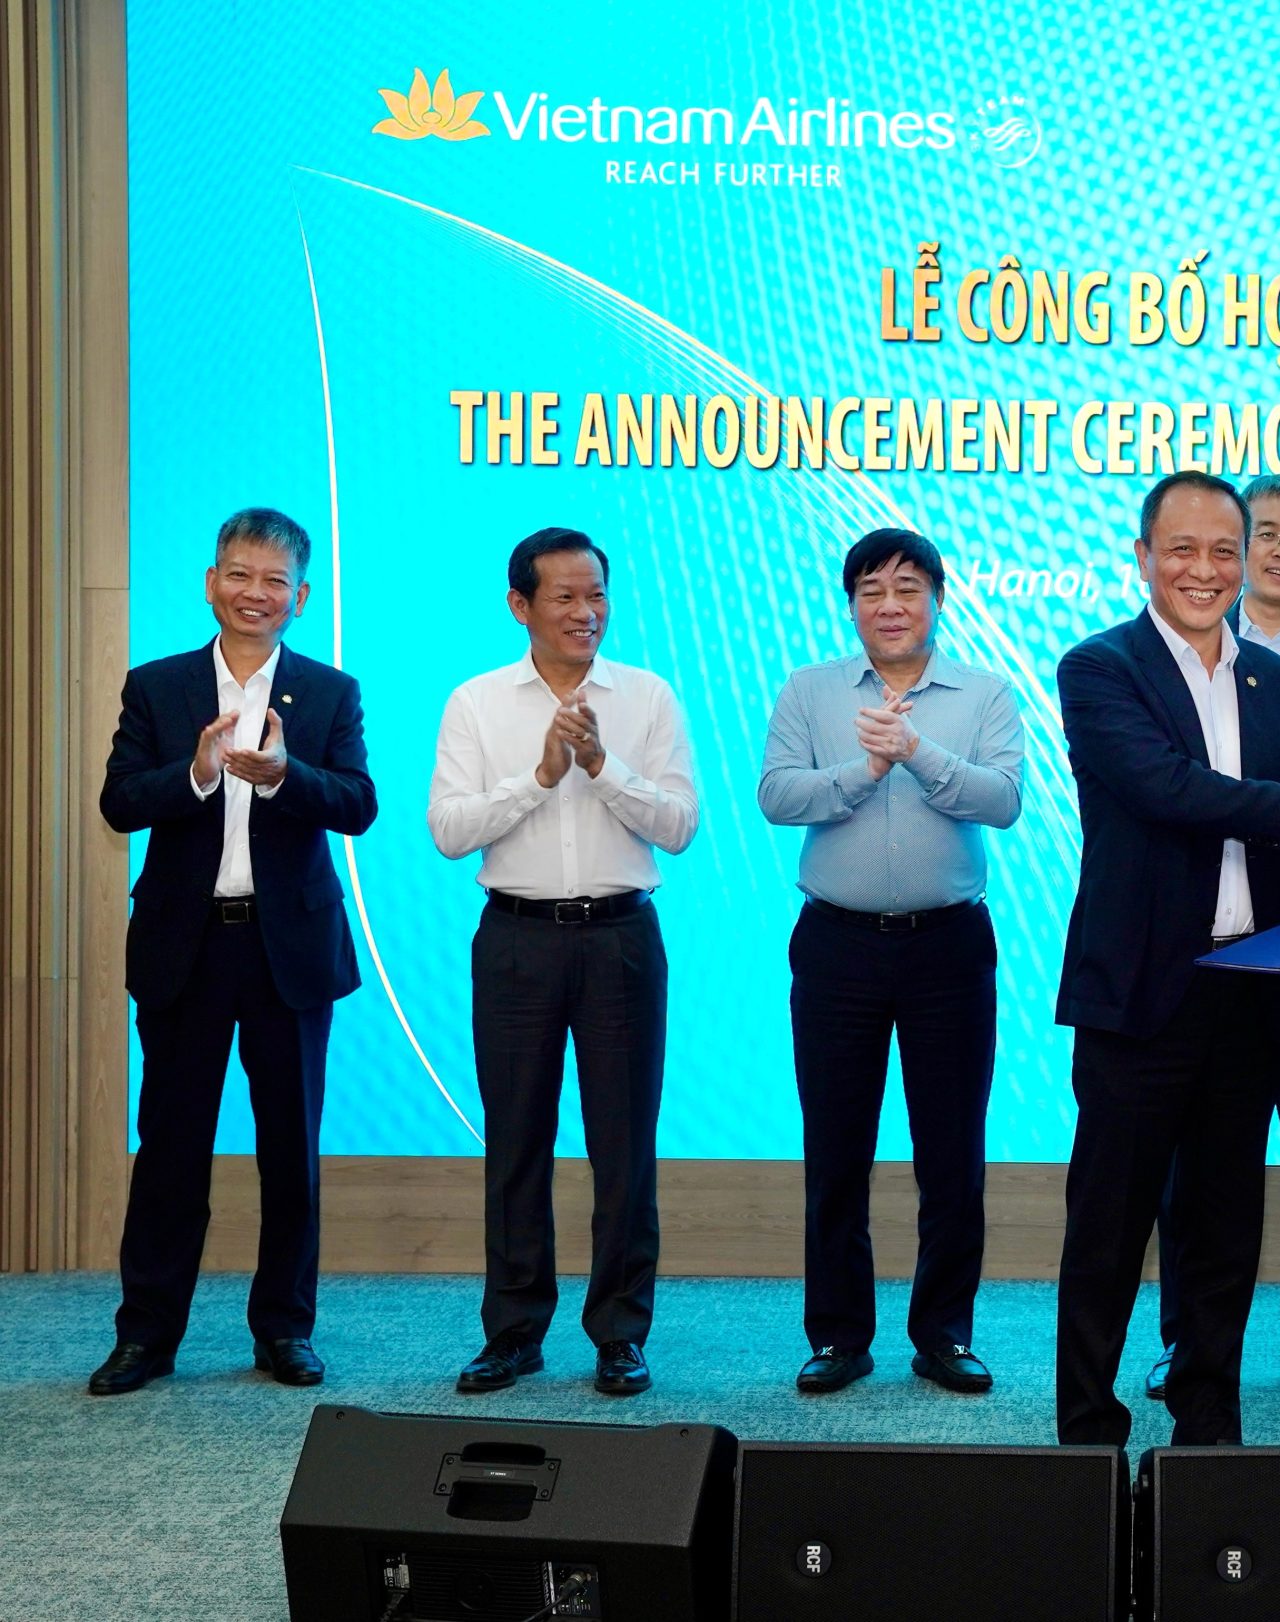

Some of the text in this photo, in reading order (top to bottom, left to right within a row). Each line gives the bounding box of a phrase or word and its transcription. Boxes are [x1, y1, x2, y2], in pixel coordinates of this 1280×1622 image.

[493, 91, 956, 150] Vietnam Airlines
[606, 161, 842, 187] REACH FURTHER
[881, 242, 941, 342] LỄ
[957, 255, 1110, 345] CÔNG
[1129, 250, 1209, 346] BỐ
[450, 391, 559, 464] THE
[574, 393, 1057, 474] ANNOUNCEMENT
[969, 559, 1099, 604] Hanoi,
[806, 1545, 821, 1573] RCF
[1227, 1550, 1242, 1579] RCF
